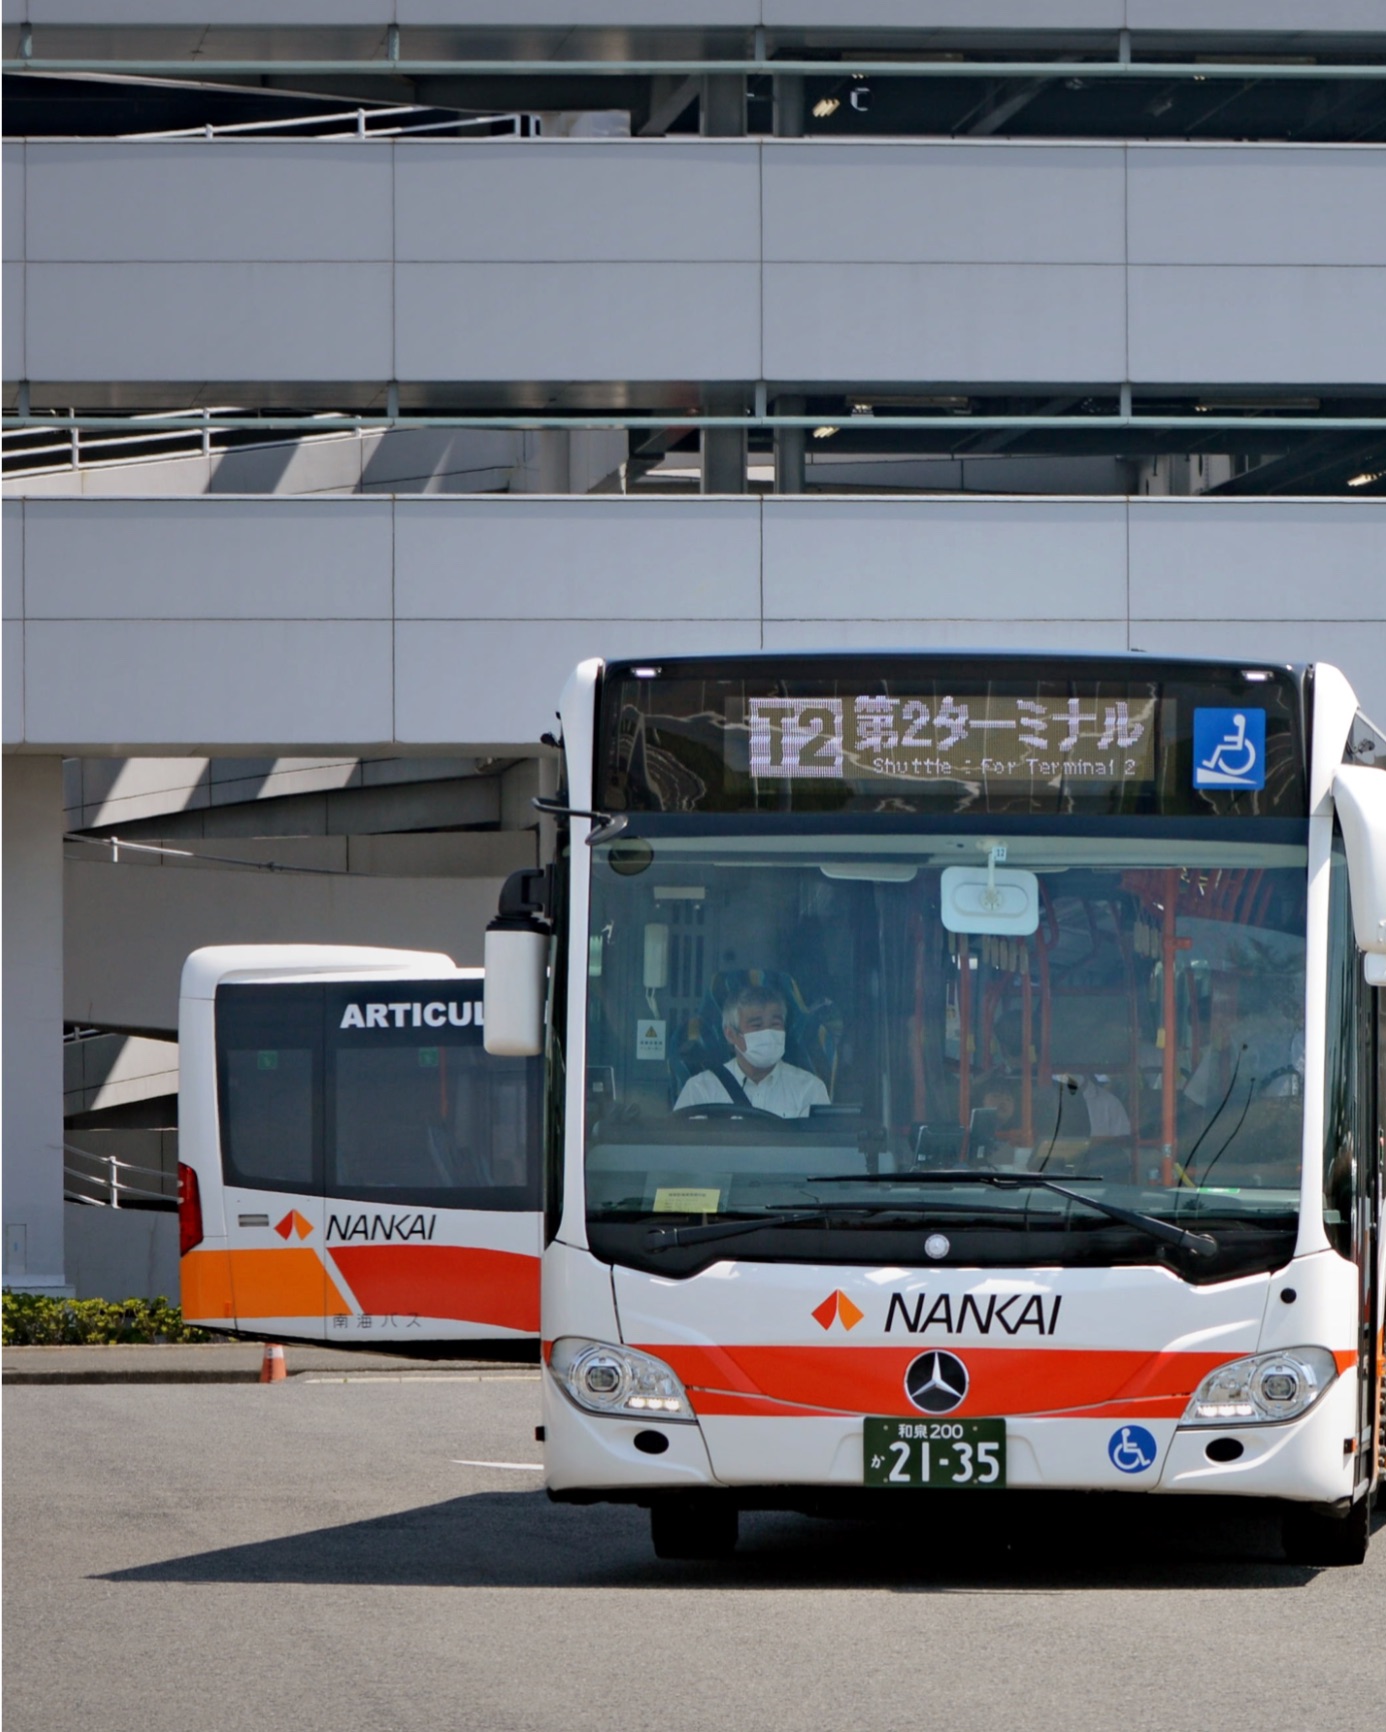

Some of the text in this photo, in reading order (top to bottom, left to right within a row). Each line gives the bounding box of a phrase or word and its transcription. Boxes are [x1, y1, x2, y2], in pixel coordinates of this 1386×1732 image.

[854, 695, 1146, 751] 第2ターミナル
[981, 758, 1016, 776] For
[1027, 758, 1115, 776] Terminal
[1124, 758, 1137, 776] 2
[326, 1214, 437, 1241] NANKAI
[333, 1312, 422, 1329] 南海バス
[884, 1292, 1062, 1335] NANKAI
[871, 1441, 1000, 1483] か 21-35
